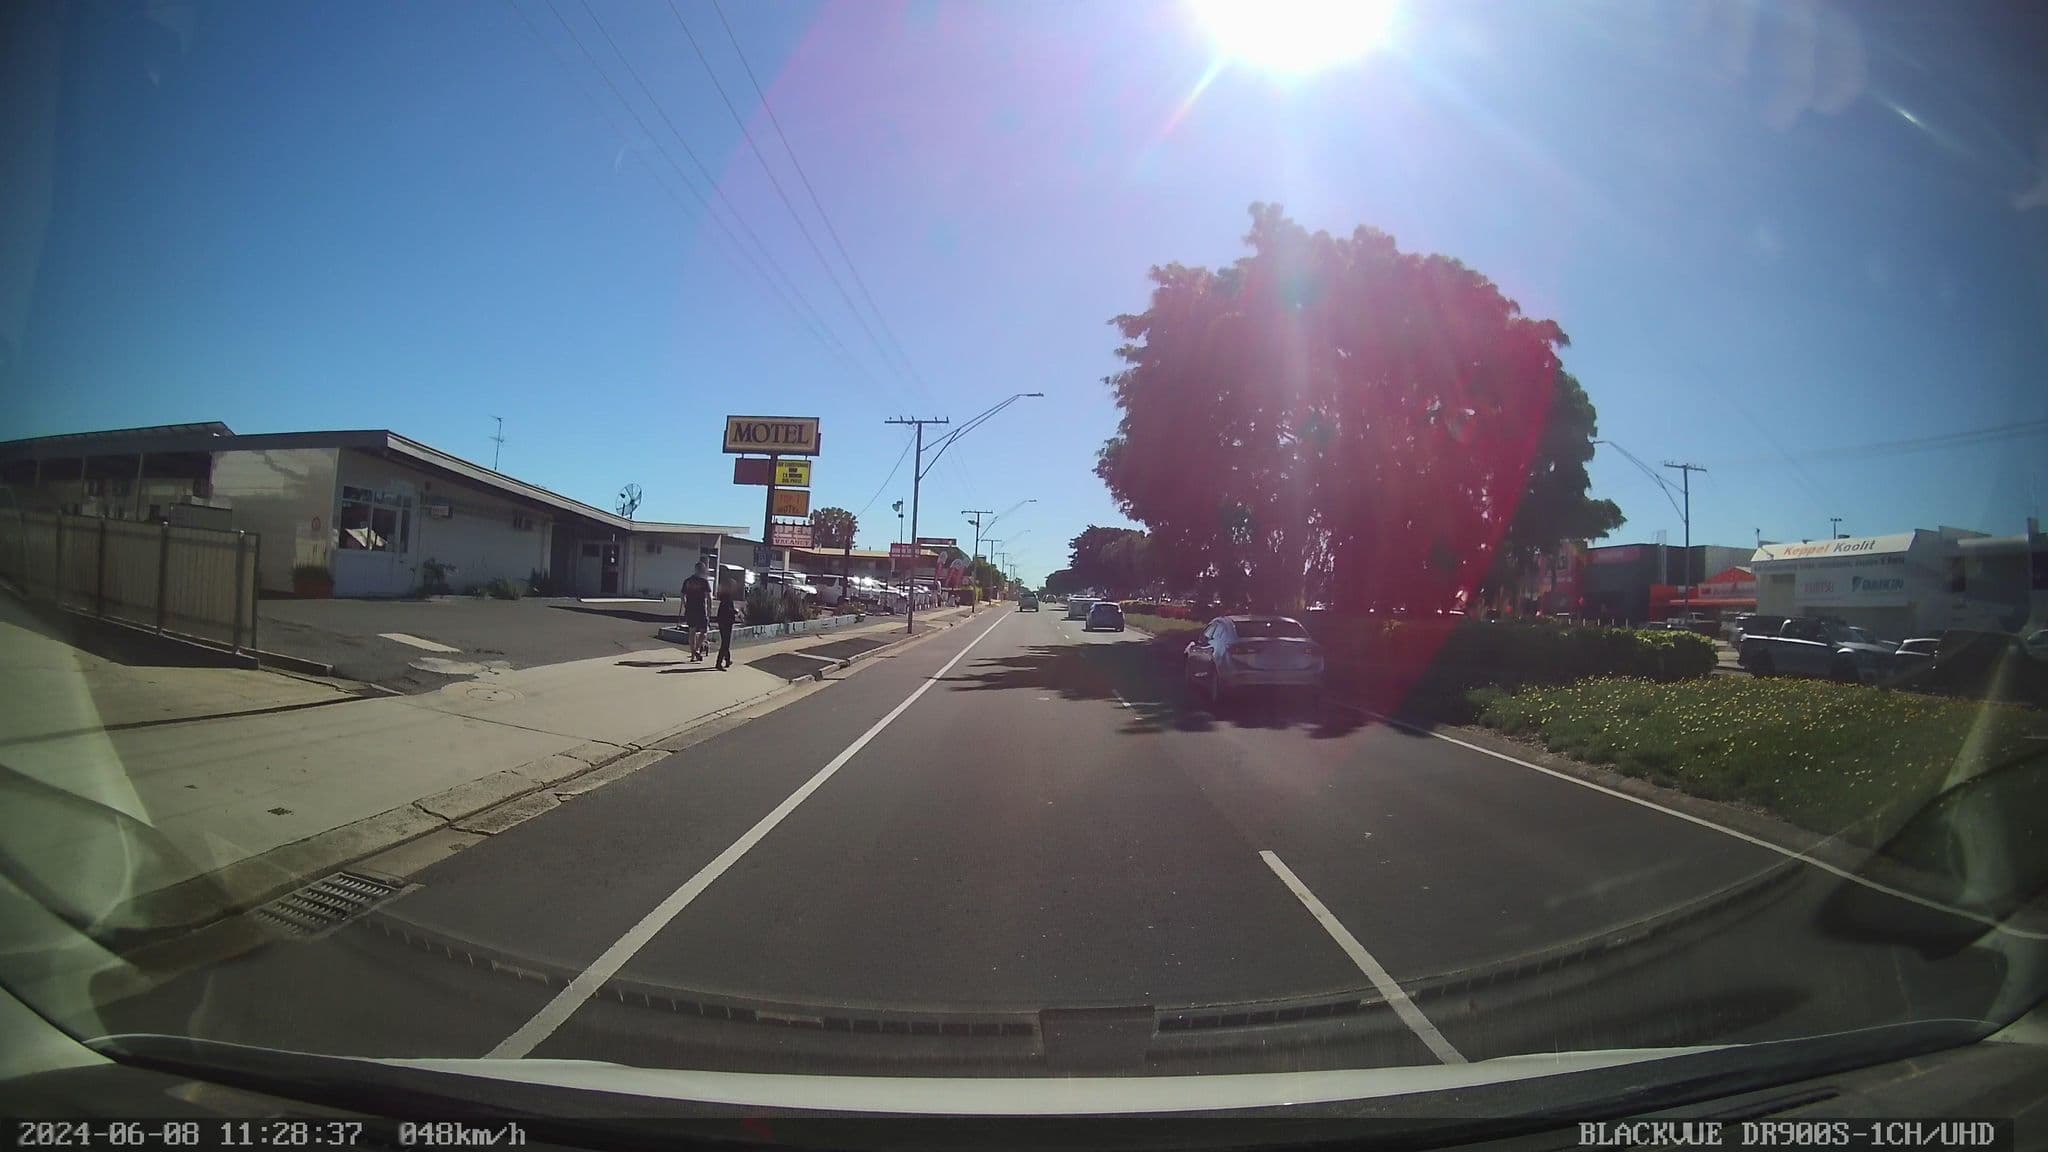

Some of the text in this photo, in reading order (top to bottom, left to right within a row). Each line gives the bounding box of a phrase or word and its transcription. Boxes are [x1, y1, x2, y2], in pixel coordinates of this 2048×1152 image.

[732, 422, 809, 444] MOTEL
[774, 525, 812, 535] OPEN
[774, 538, 811, 547] VACANCY
[1783, 539, 1877, 557] Keppel Koolit
